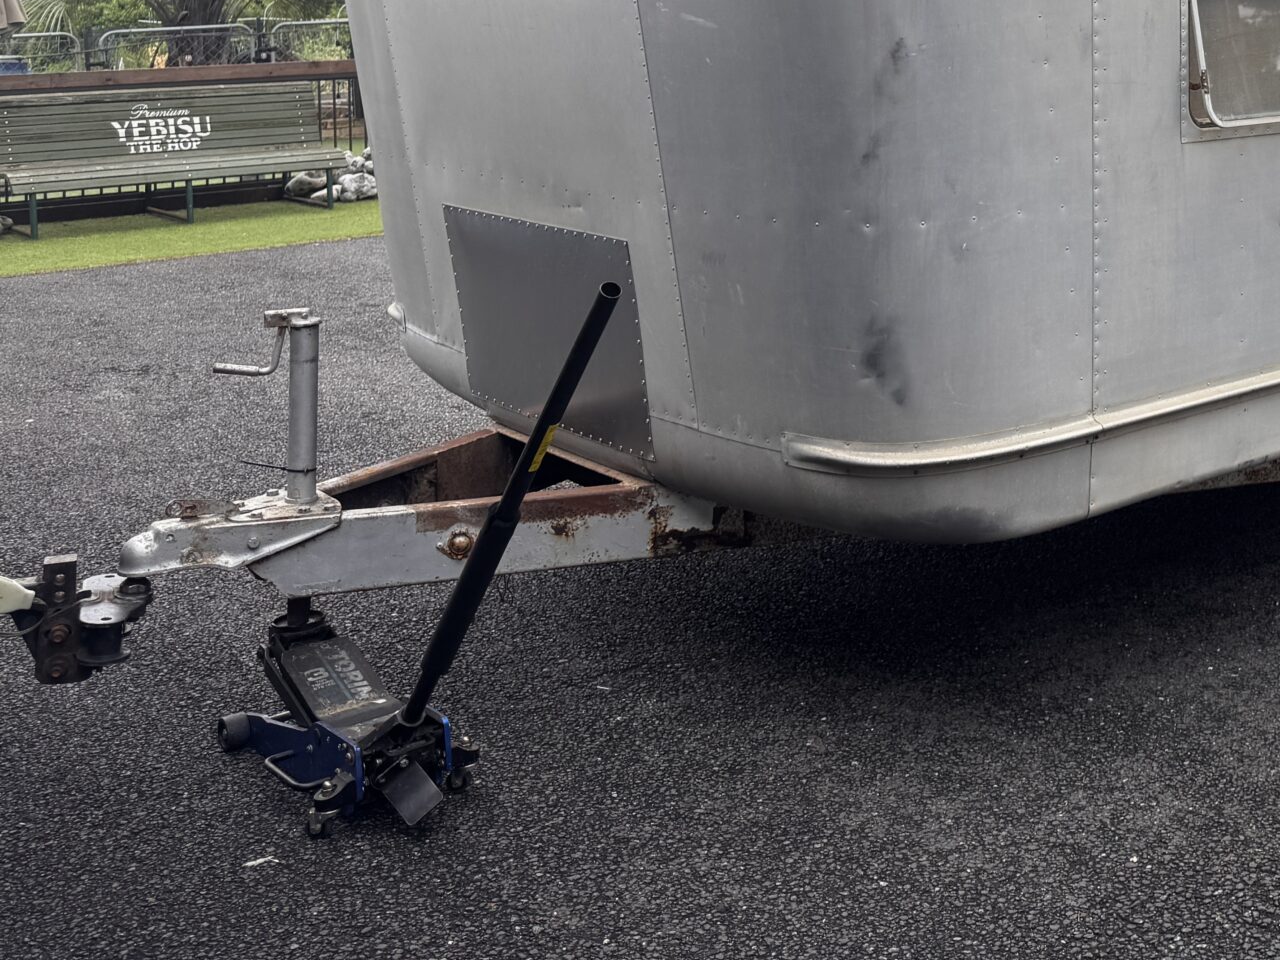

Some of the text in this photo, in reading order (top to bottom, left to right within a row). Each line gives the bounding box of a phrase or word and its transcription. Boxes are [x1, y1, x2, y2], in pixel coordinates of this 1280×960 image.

[129, 103, 190, 119] Premium
[110, 115, 211, 142] YEBISU
[126, 137, 201, 154] THE HOP
